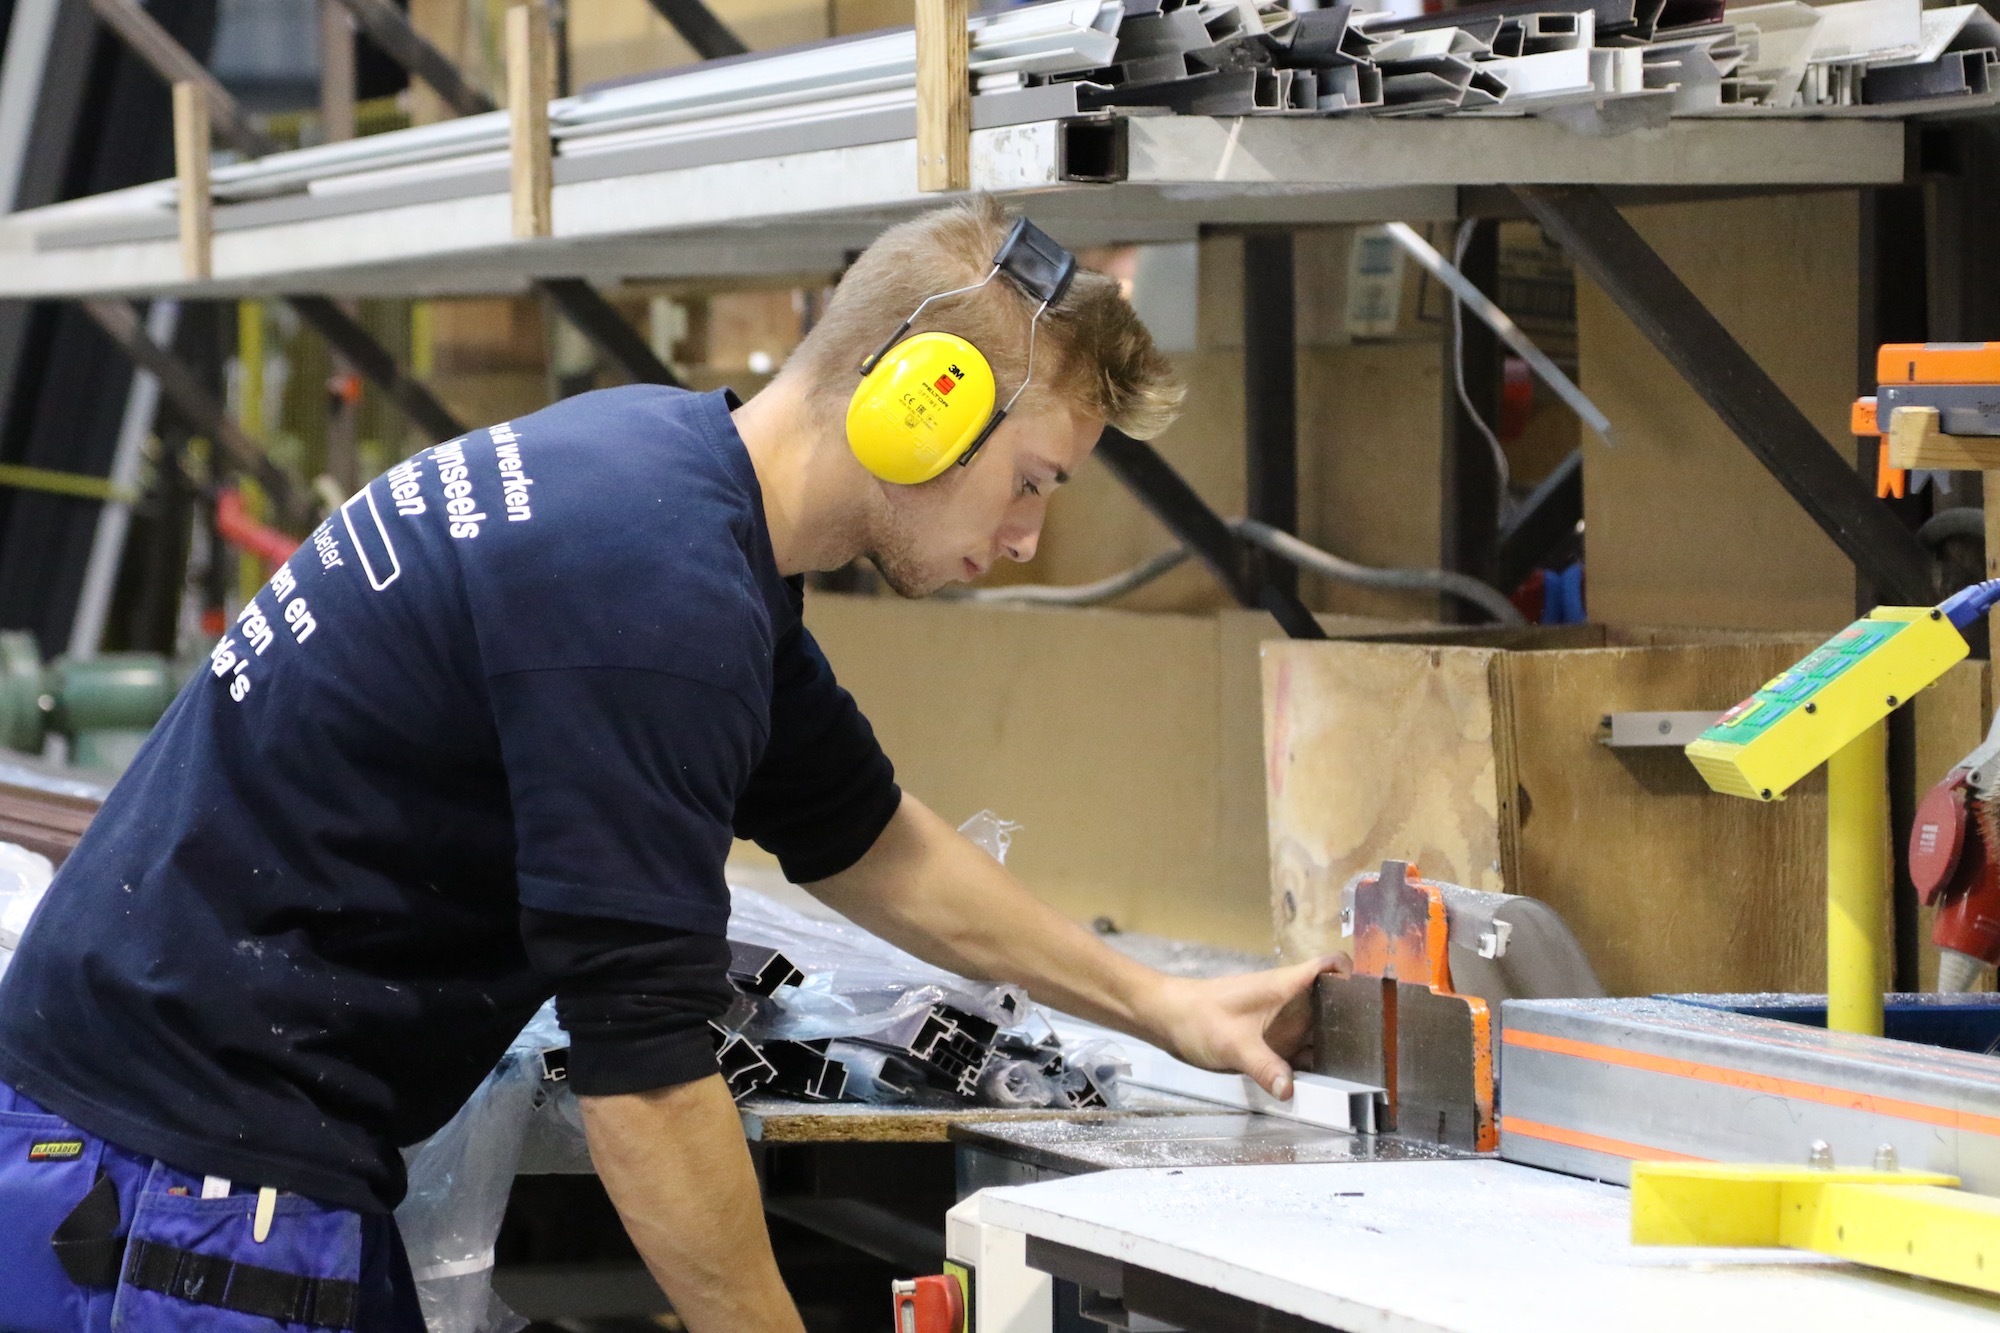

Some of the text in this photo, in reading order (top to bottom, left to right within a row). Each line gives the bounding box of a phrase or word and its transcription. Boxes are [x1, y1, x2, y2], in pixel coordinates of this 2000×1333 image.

[948, 364, 965, 380] 3M
[922, 382, 949, 408] PELTOR
[495, 443, 534, 522] werken
[284, 597, 317, 644] en
